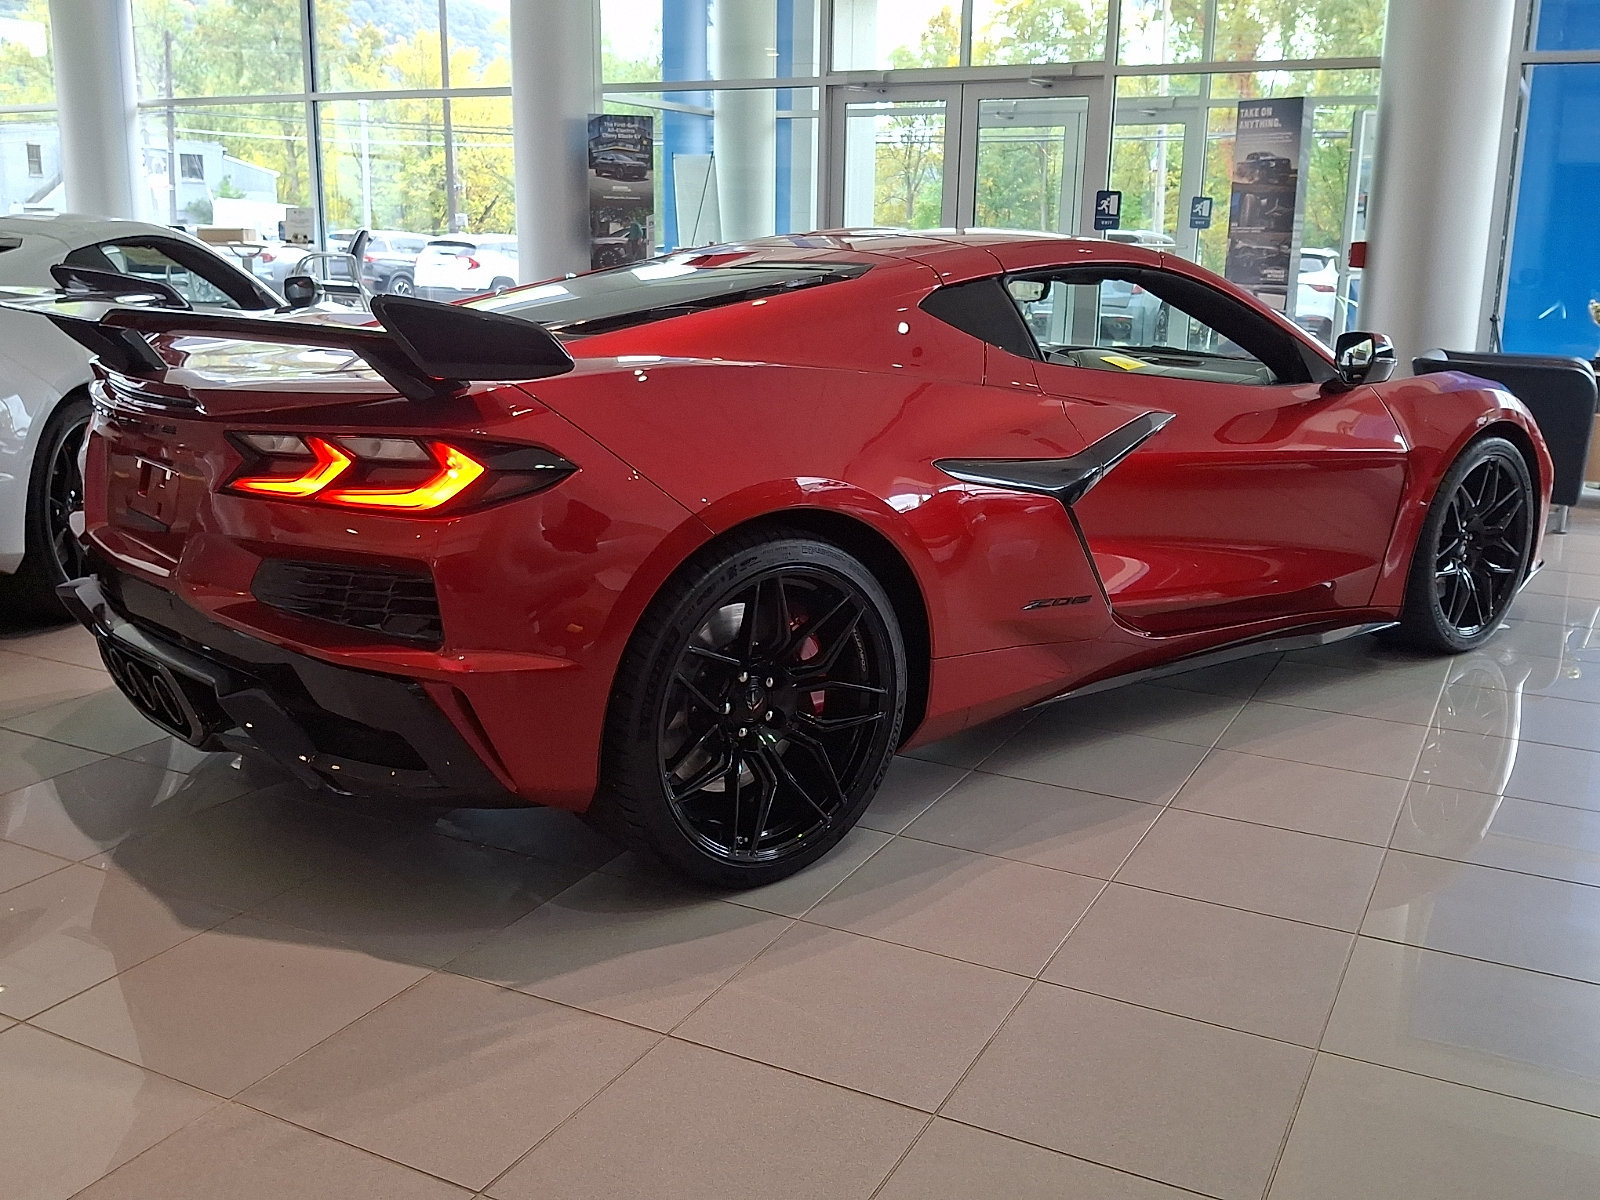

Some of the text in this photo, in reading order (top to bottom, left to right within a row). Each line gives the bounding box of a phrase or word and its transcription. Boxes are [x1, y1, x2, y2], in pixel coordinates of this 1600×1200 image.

[1240, 106, 1273, 118] TAKE ON
[1239, 118, 1282, 129] ANYTHING.
[1022, 594, 1093, 611] Z06
